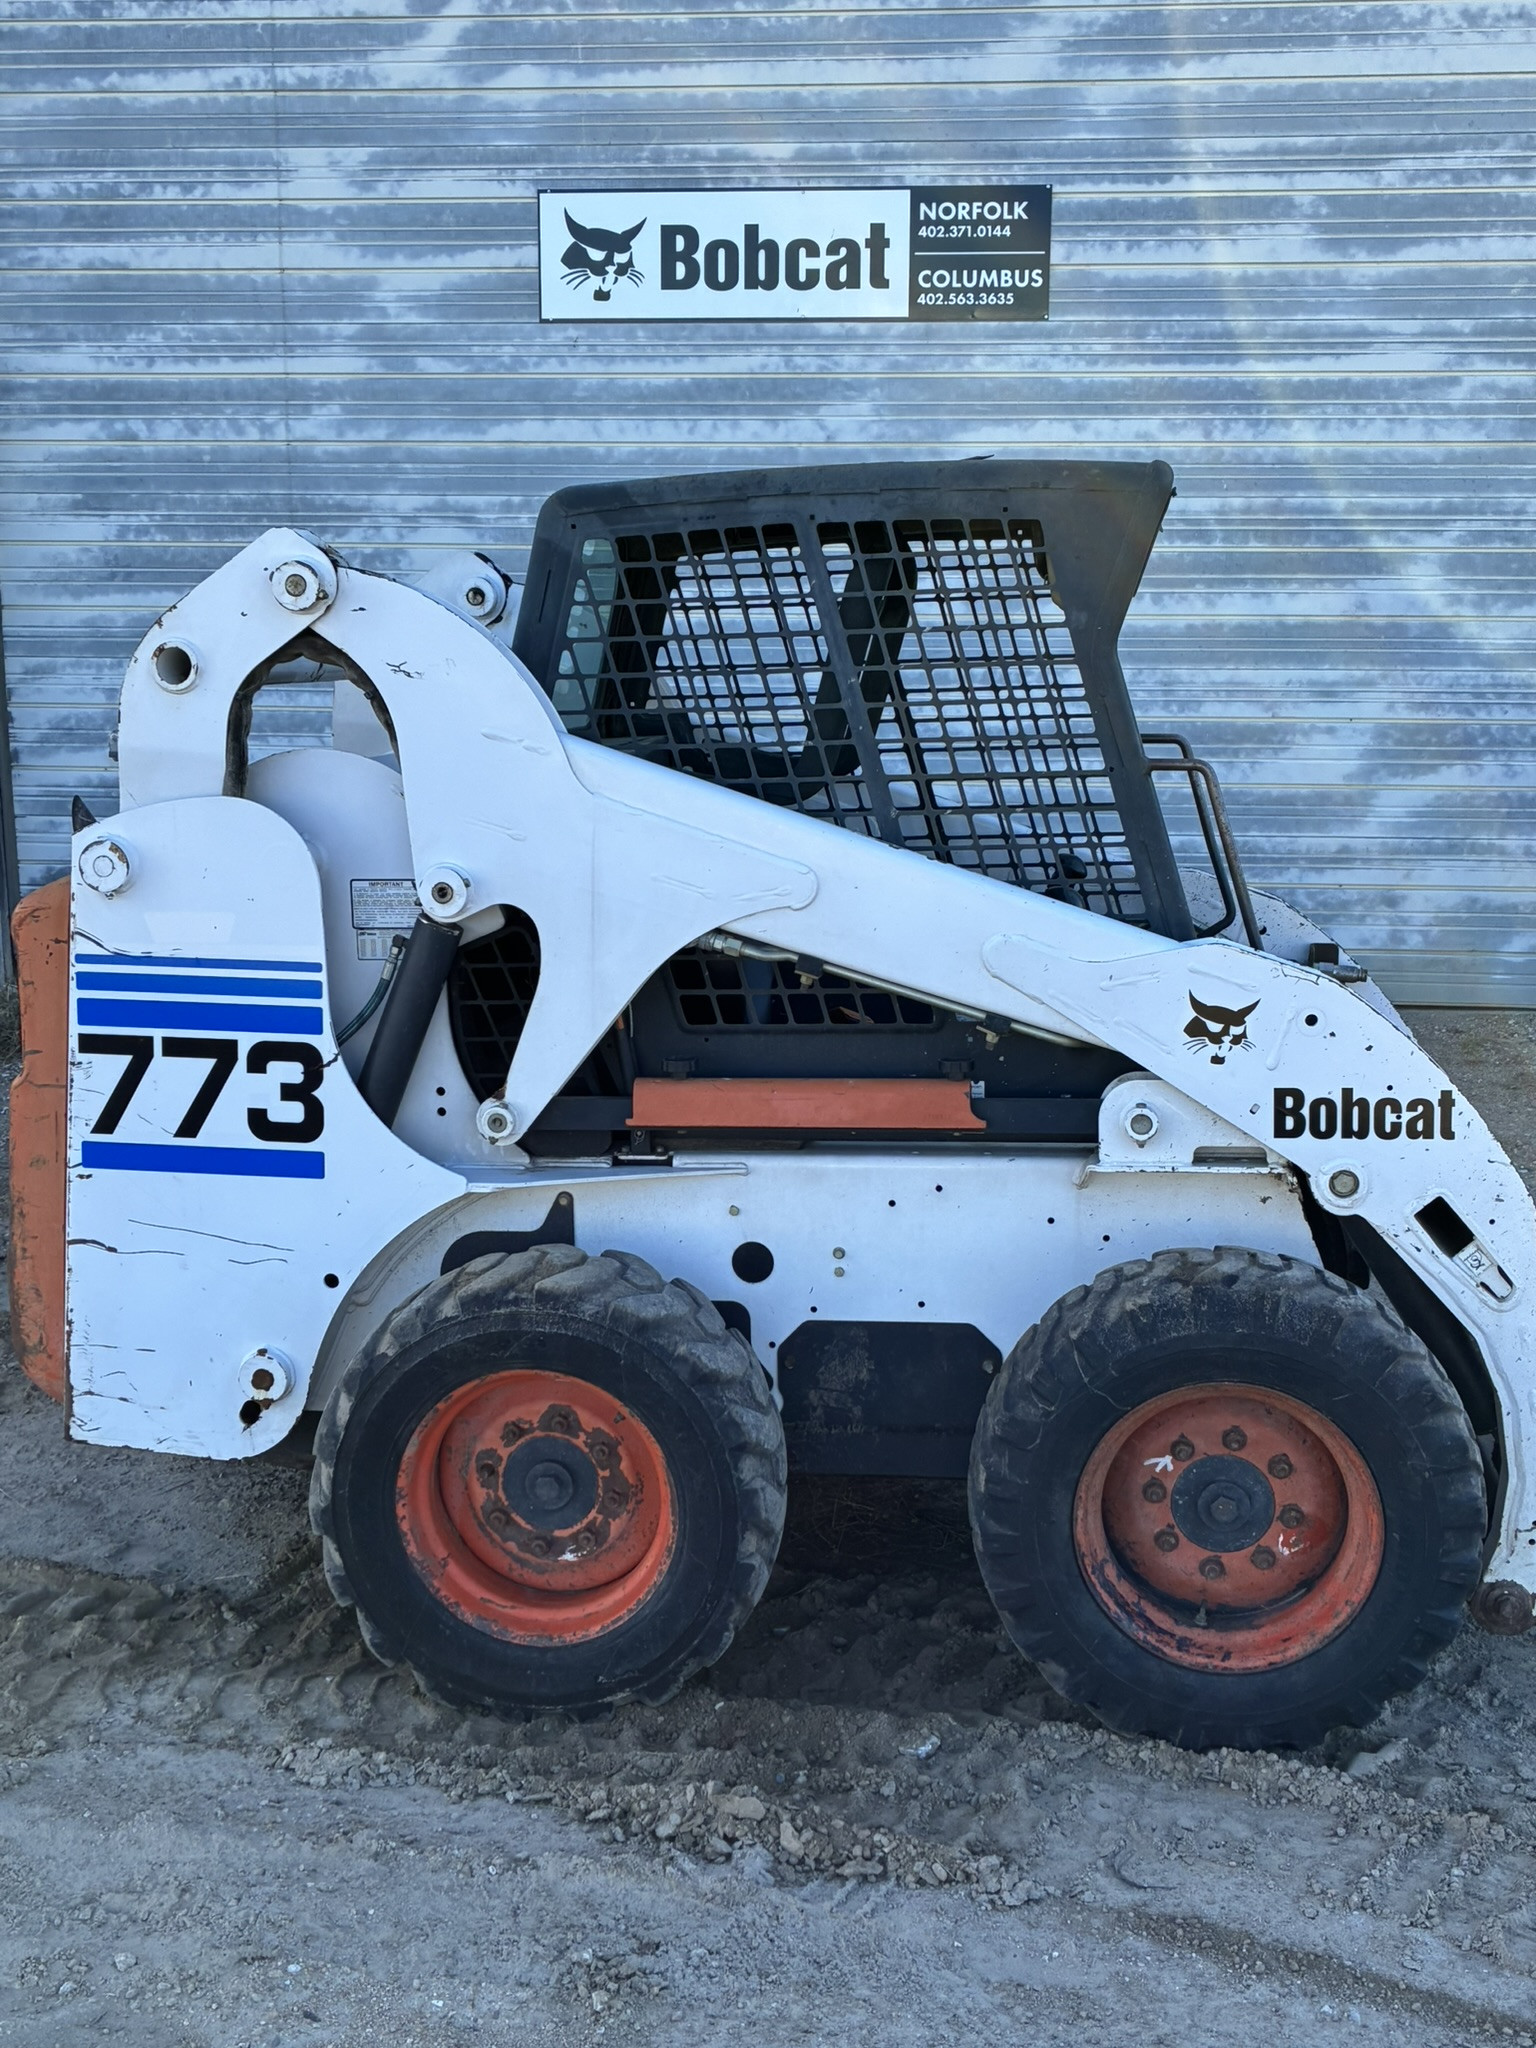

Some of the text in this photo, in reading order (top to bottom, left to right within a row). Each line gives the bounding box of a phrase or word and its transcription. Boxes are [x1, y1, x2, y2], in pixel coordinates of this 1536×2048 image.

[919, 201, 1029, 220] NORFOLK
[918, 225, 1012, 238] 402.371.0144
[660, 223, 890, 291] Bobcat
[918, 269, 1044, 288] COLUMBUS
[917, 293, 1015, 305] 402.563.3635
[79, 1033, 325, 1143] 773
[1273, 1088, 1456, 1140] Bobcat
